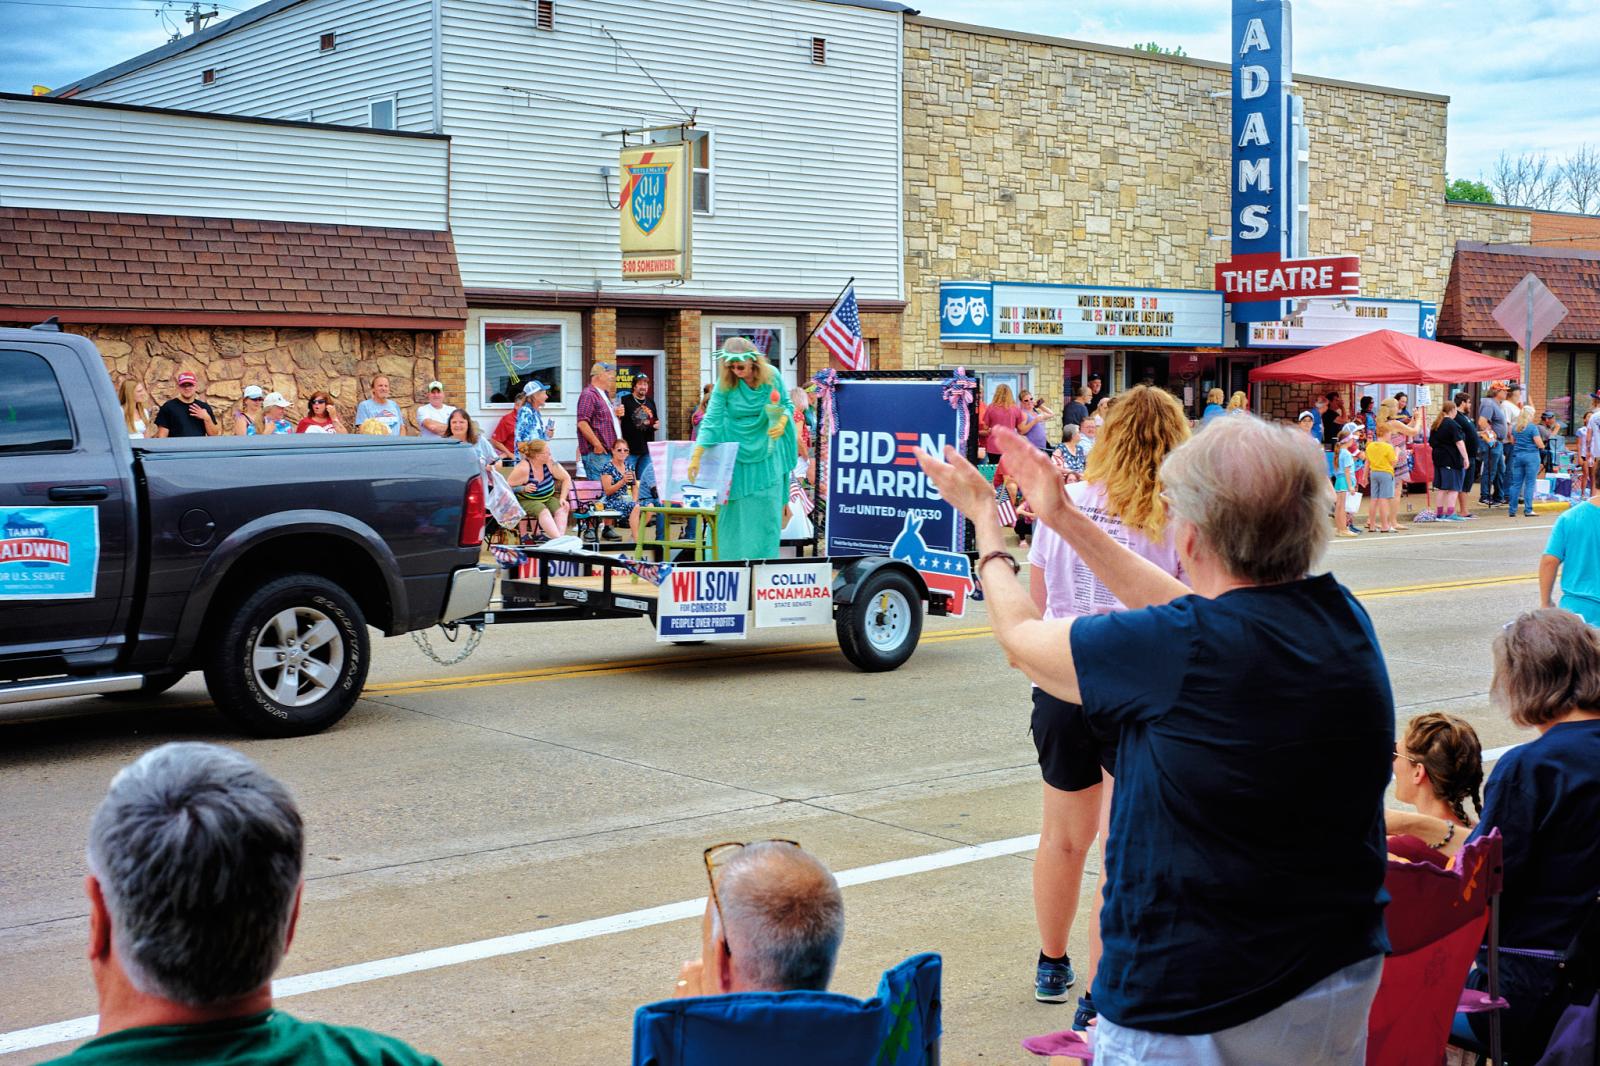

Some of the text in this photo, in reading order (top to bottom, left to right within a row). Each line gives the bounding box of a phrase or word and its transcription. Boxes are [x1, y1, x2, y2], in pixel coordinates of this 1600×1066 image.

[1238, 18, 1271, 240] ADAMS
[640, 175, 659, 198] Old
[634, 195, 663, 228] Style
[623, 259, 675, 272] 5:00 SOMEWHERE
[1221, 265, 1334, 293] THEATRE
[1078, 295, 1100, 307] MOVIES
[1101, 296, 1135, 309] THURSDAYS
[1000, 306, 1062, 321] JUL 11 JOHN WICK 4
[1082, 309, 1092, 322] JUL
[1094, 309, 1102, 321] 25
[1105, 310, 1123, 322] MAGIC
[1141, 312, 1155, 323] LAST
[1156, 312, 1174, 324] DANCE
[1000, 321, 1063, 335] JUL 18 OPPENHEIMER
[1109, 324, 1116, 336] 27
[838, 430, 946, 466] BIDEN
[836, 467, 944, 501] HARRIS
[839, 504, 856, 514] Text
[856, 505, 896, 517] UNITED
[897, 509, 906, 518] to
[7, 527, 46, 537] TAMMY
[0, 542, 67, 560] ALDWIN
[12, 571, 31, 581] U.S.
[32, 571, 66, 581] SENATE
[771, 573, 816, 586] COLLIN
[672, 570, 740, 603] WILSON
[756, 586, 831, 601] MCNAMARA
[691, 602, 727, 613] CONGRESS
[792, 600, 812, 608] SENATE
[671, 616, 736, 629] PEOPLE OVER PROFITS
